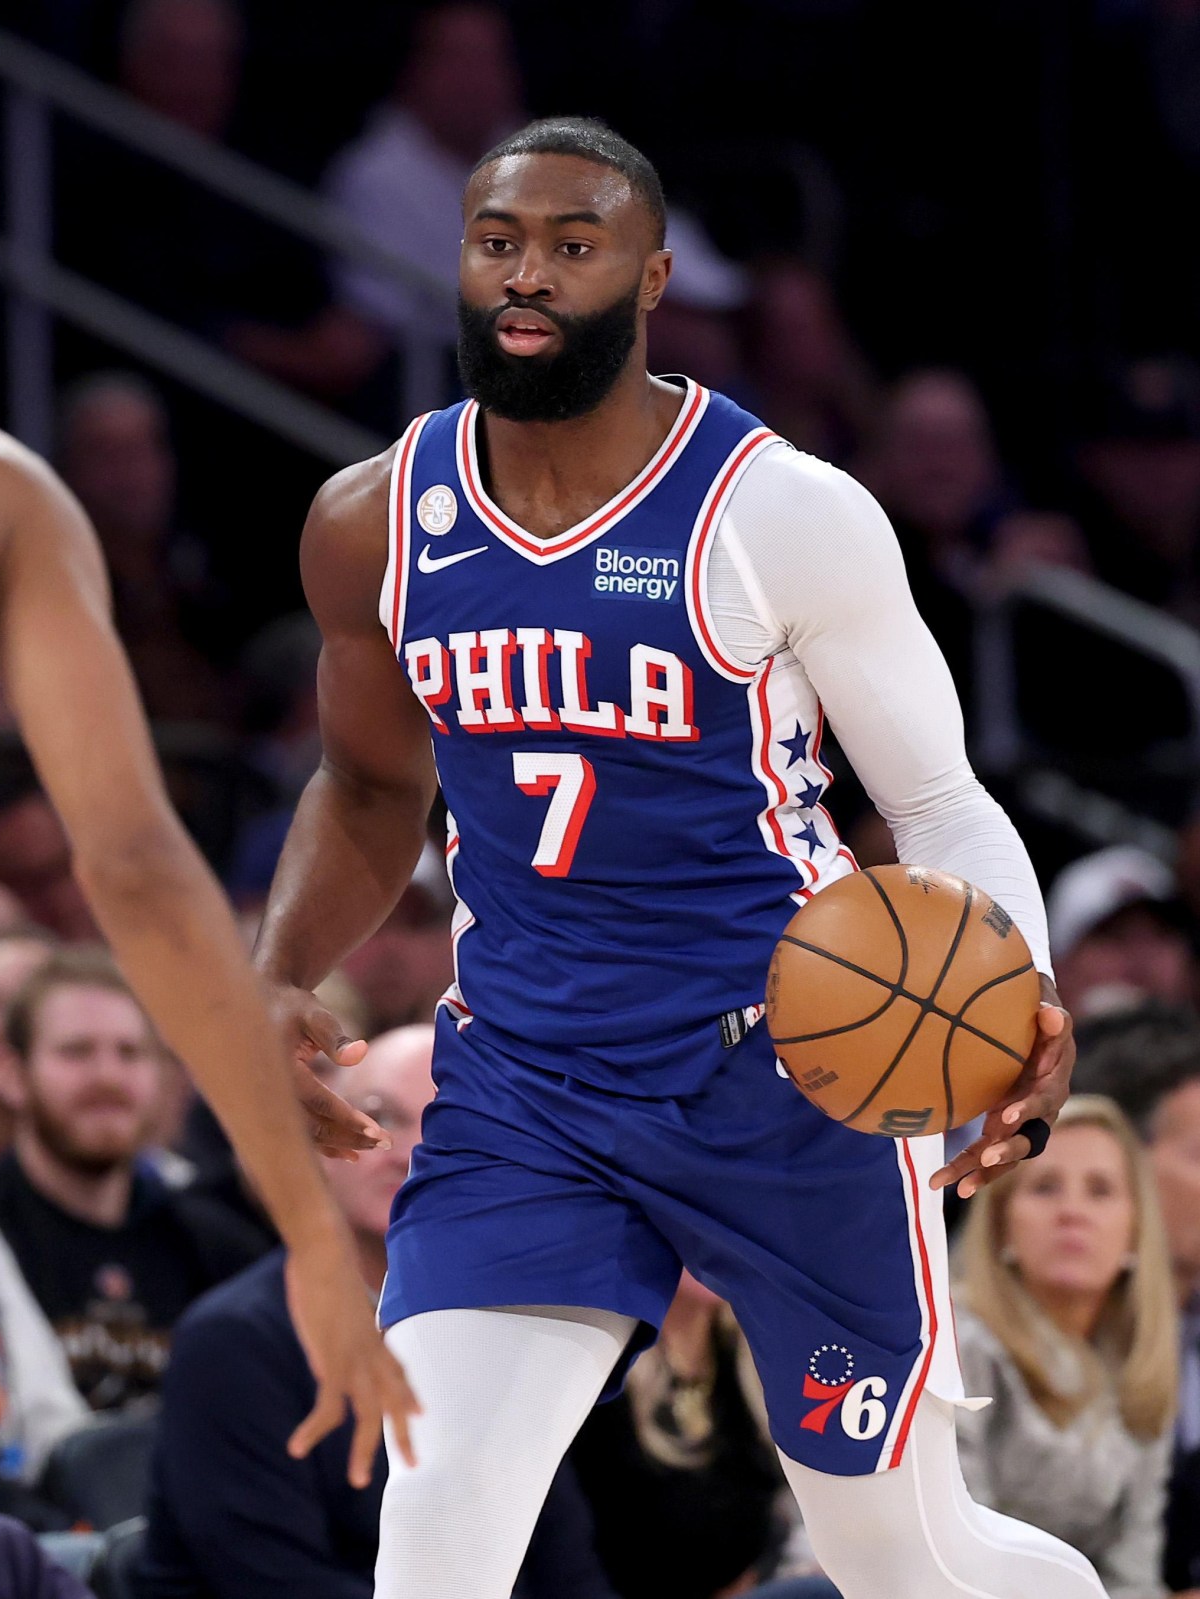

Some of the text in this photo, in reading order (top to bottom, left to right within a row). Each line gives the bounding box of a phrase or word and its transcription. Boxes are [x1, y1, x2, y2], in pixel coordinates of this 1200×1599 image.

[594, 574, 677, 600] energy
[595, 548, 679, 577] Bloom
[404, 627, 700, 742] PHILA
[512, 752, 597, 878] 7
[800, 1373, 888, 1441] 76
